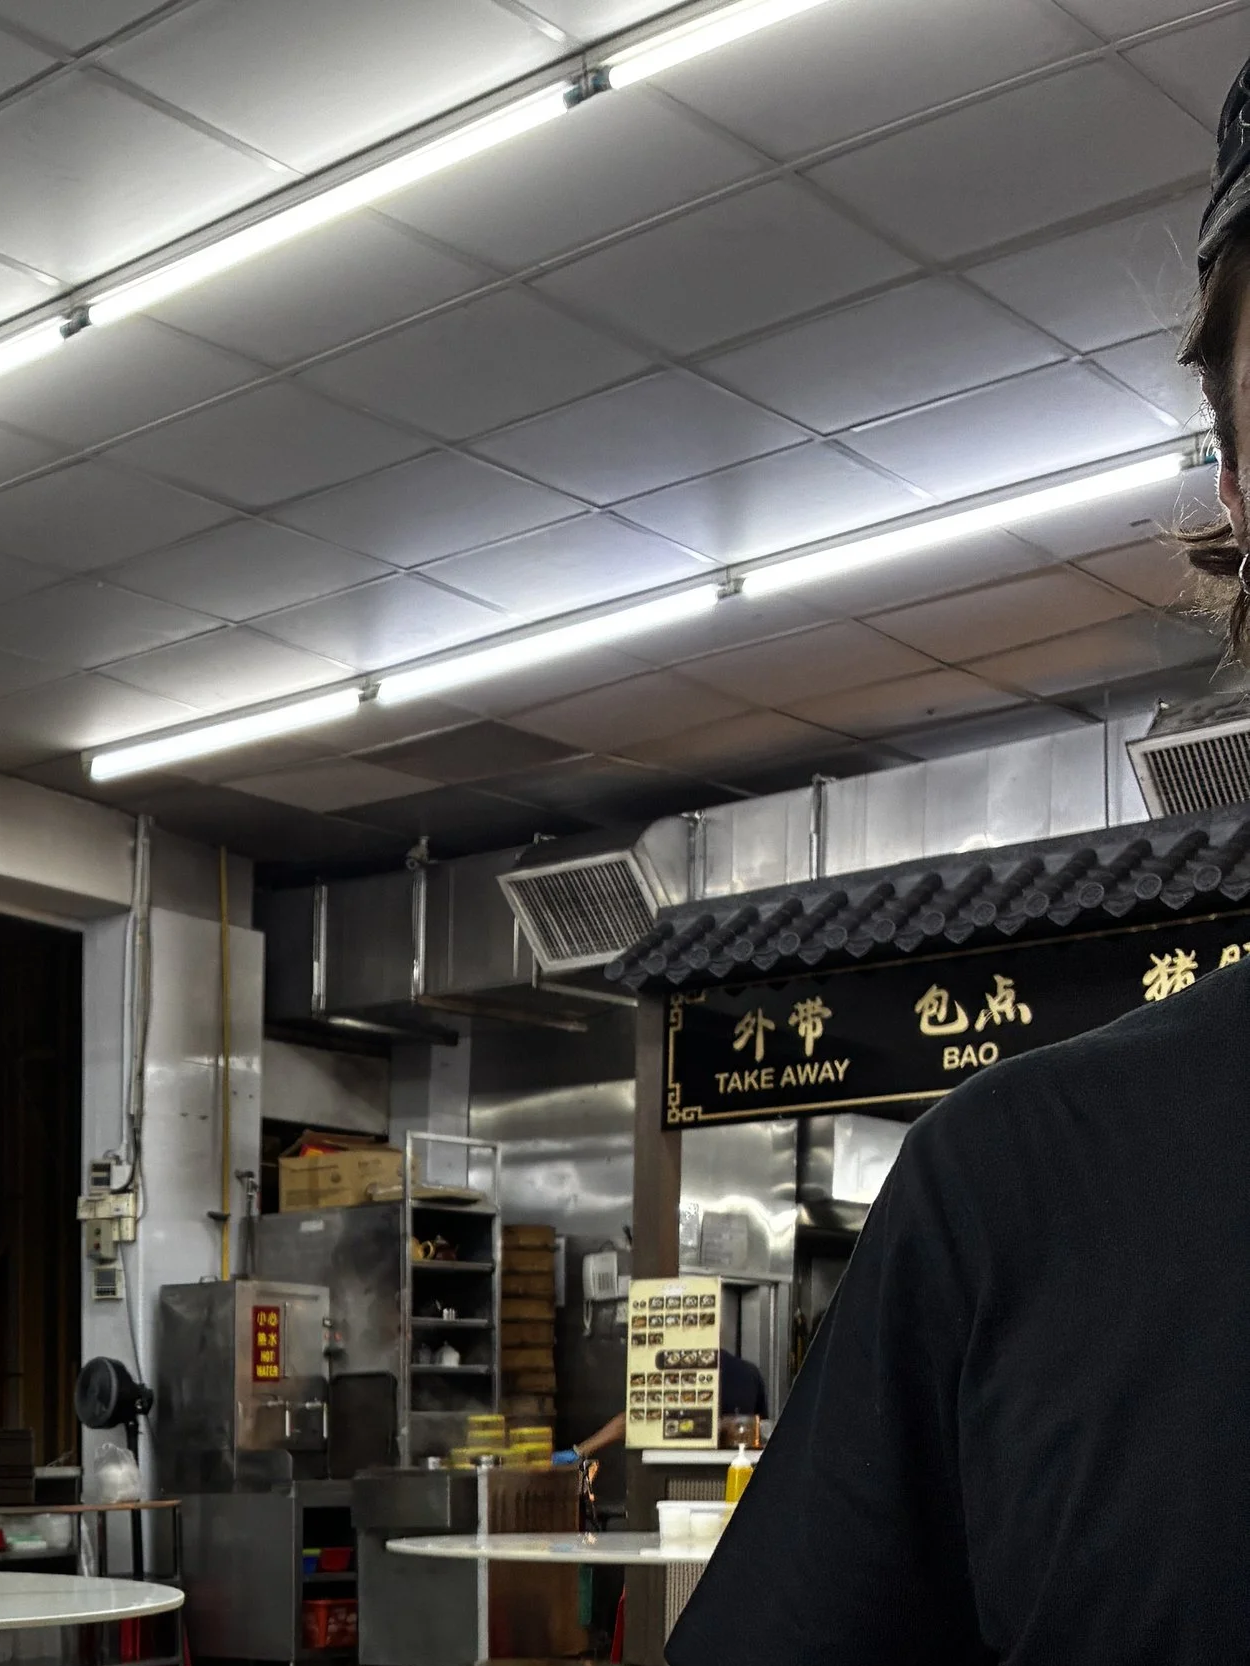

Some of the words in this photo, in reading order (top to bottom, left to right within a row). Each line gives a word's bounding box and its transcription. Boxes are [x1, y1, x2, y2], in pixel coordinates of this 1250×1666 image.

[914, 975, 1032, 1036] 包点
[715, 1067, 774, 1094] TAKE
[779, 1058, 850, 1089] AWAY
[943, 1041, 998, 1071] BAO
[257, 1311, 278, 1327] 小心
[260, 1350, 276, 1362] HOT
[256, 1365, 279, 1377] WATER
